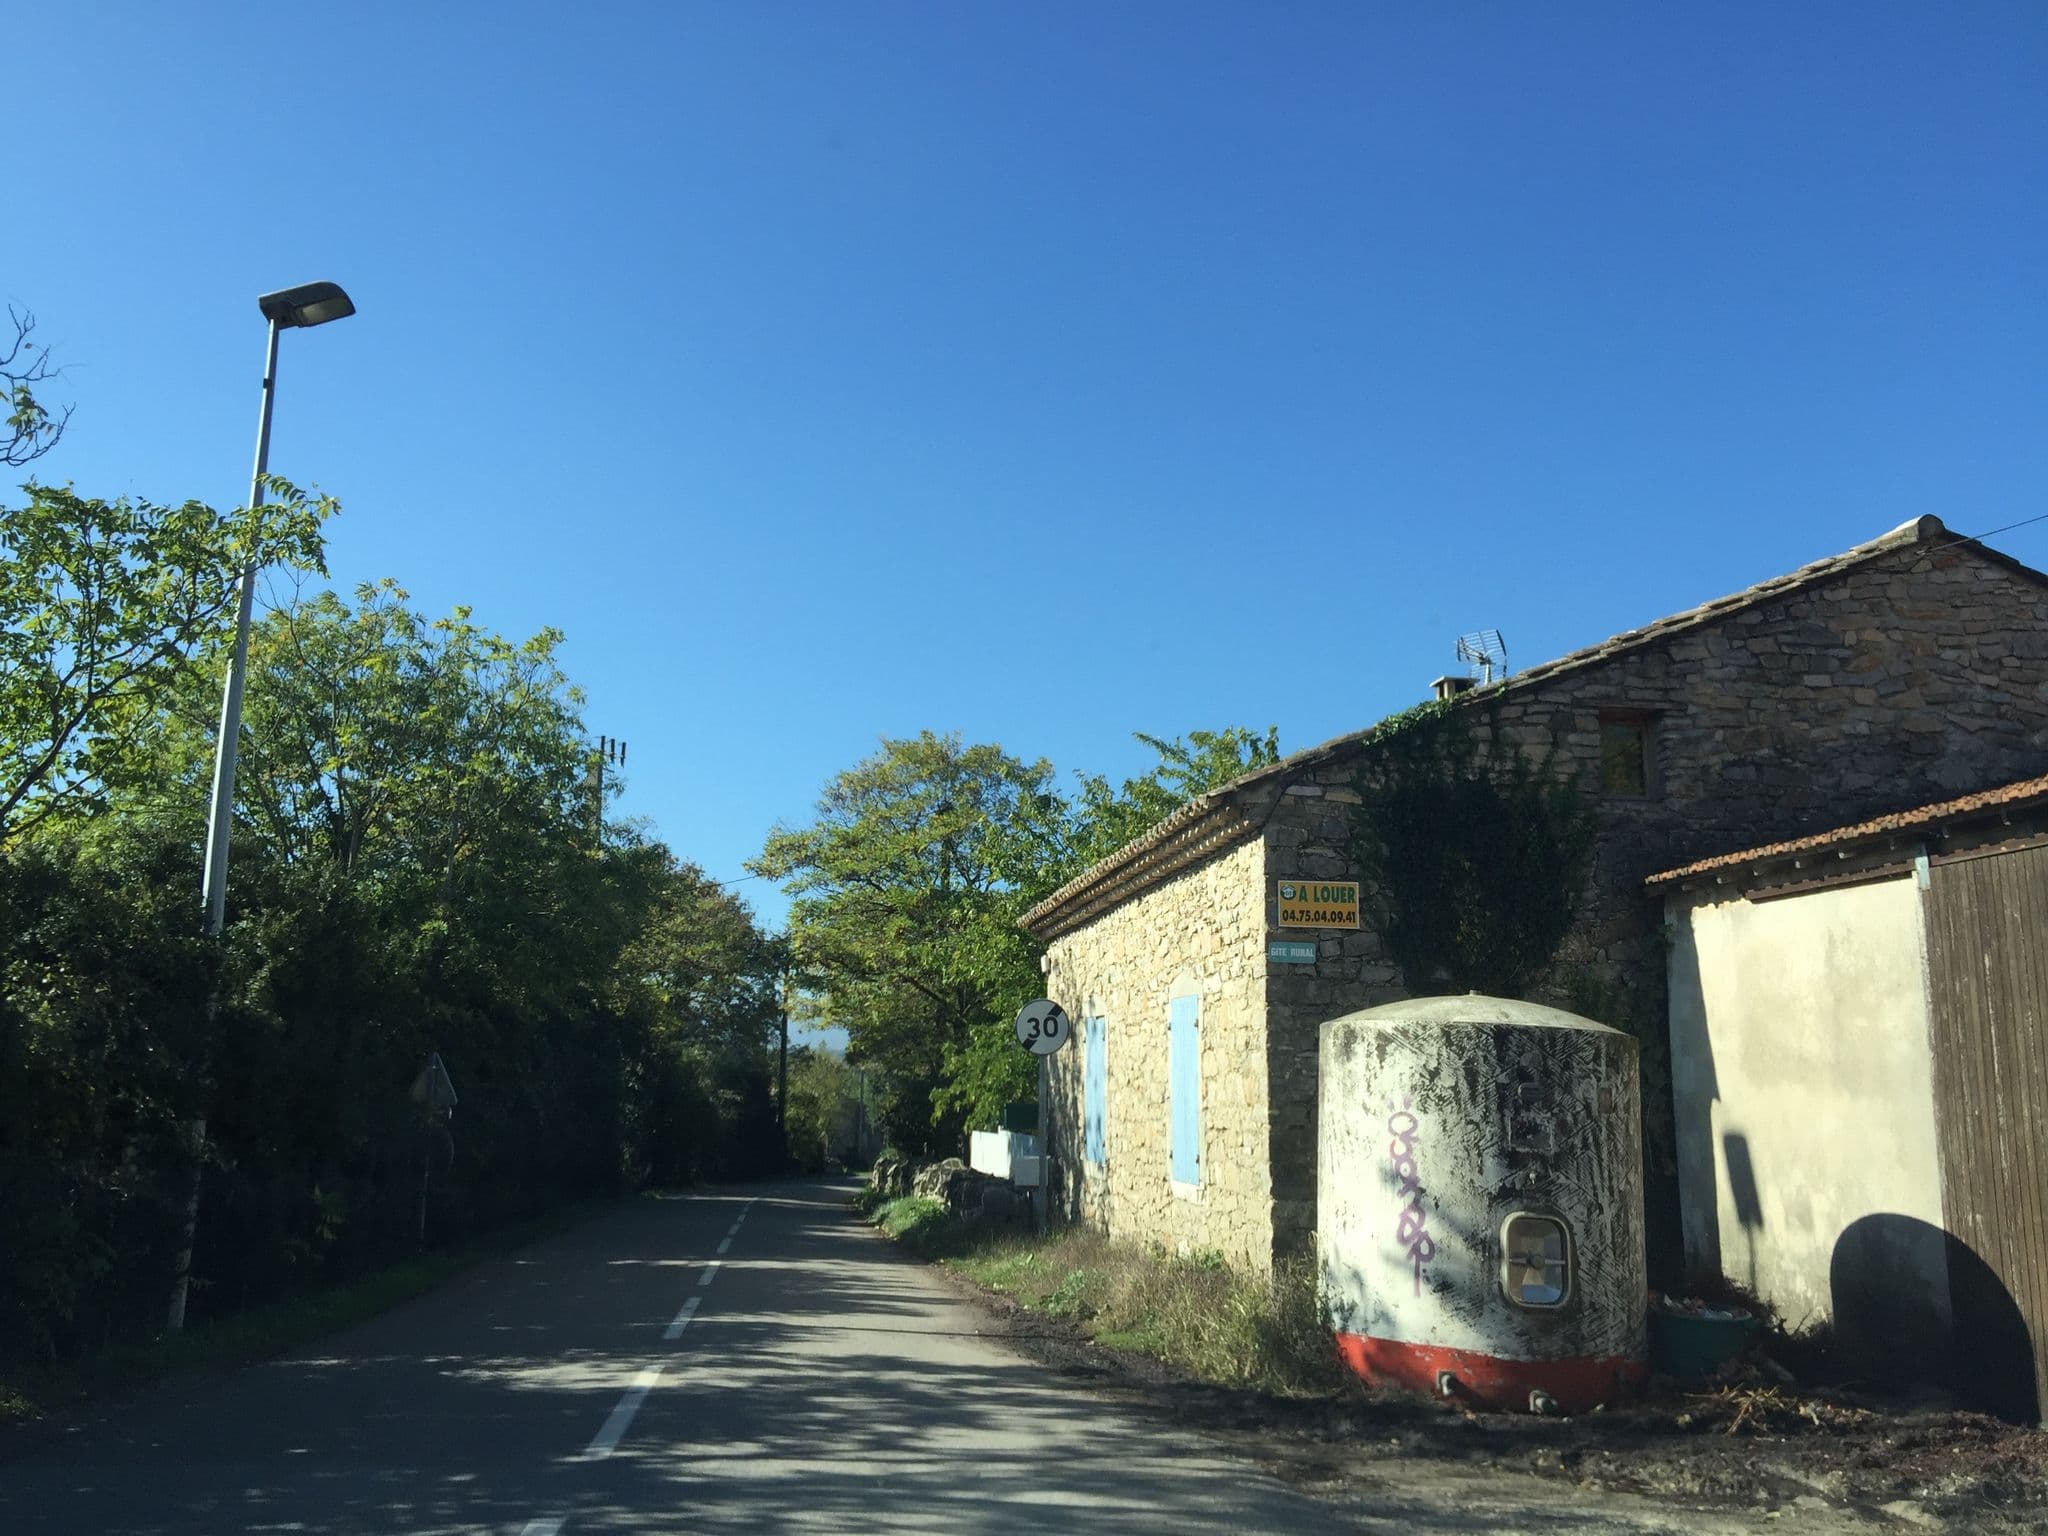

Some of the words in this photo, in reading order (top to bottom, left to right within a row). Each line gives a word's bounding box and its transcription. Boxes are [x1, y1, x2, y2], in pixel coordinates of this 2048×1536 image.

[1299, 885, 1308, 902] A
[1313, 886, 1355, 903] LOUER
[1282, 909, 1356, 923] 04.75.04.09.41
[1290, 948, 1315, 958] RURAL
[1027, 1016, 1059, 1039] 30
